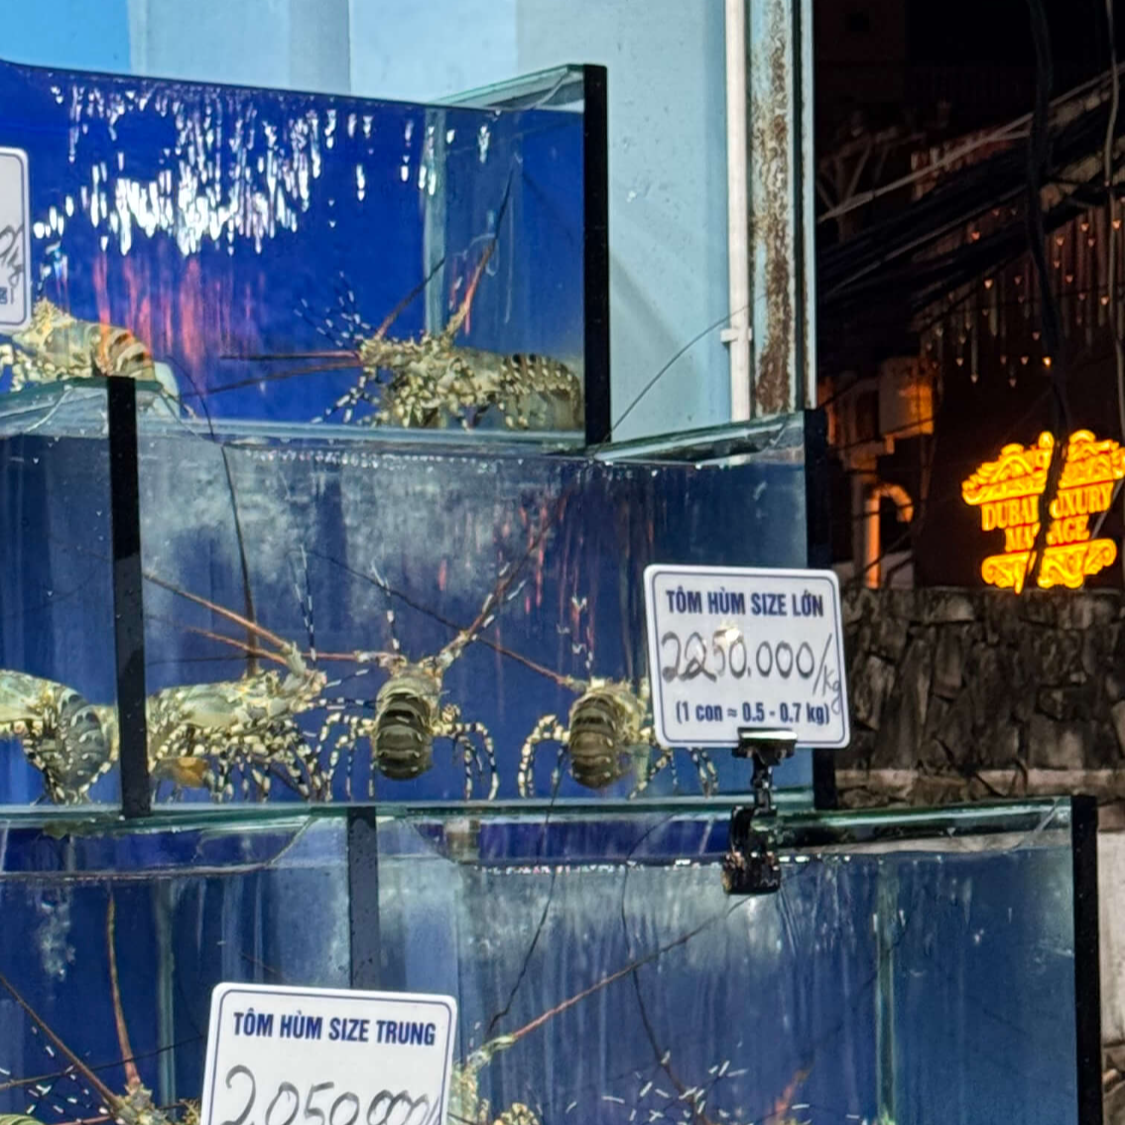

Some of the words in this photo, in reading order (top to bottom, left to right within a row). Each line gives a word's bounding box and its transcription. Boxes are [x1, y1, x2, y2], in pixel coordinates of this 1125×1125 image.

[666, 585, 703, 614] TÔM
[707, 586, 746, 616] HÙM
[751, 592, 788, 617] SIZE
[792, 590, 824, 618] LỚN
[676, 701, 689, 723] (1
[695, 703, 723, 722] con
[742, 702, 765, 722] 0.5
[780, 702, 802, 723] 0.7
[806, 702, 830, 725] kg)
[233, 1008, 274, 1038] TÔM
[280, 1010, 323, 1040] HÙM
[329, 1017, 370, 1043] SIZE
[376, 1019, 437, 1046] TRUNG
